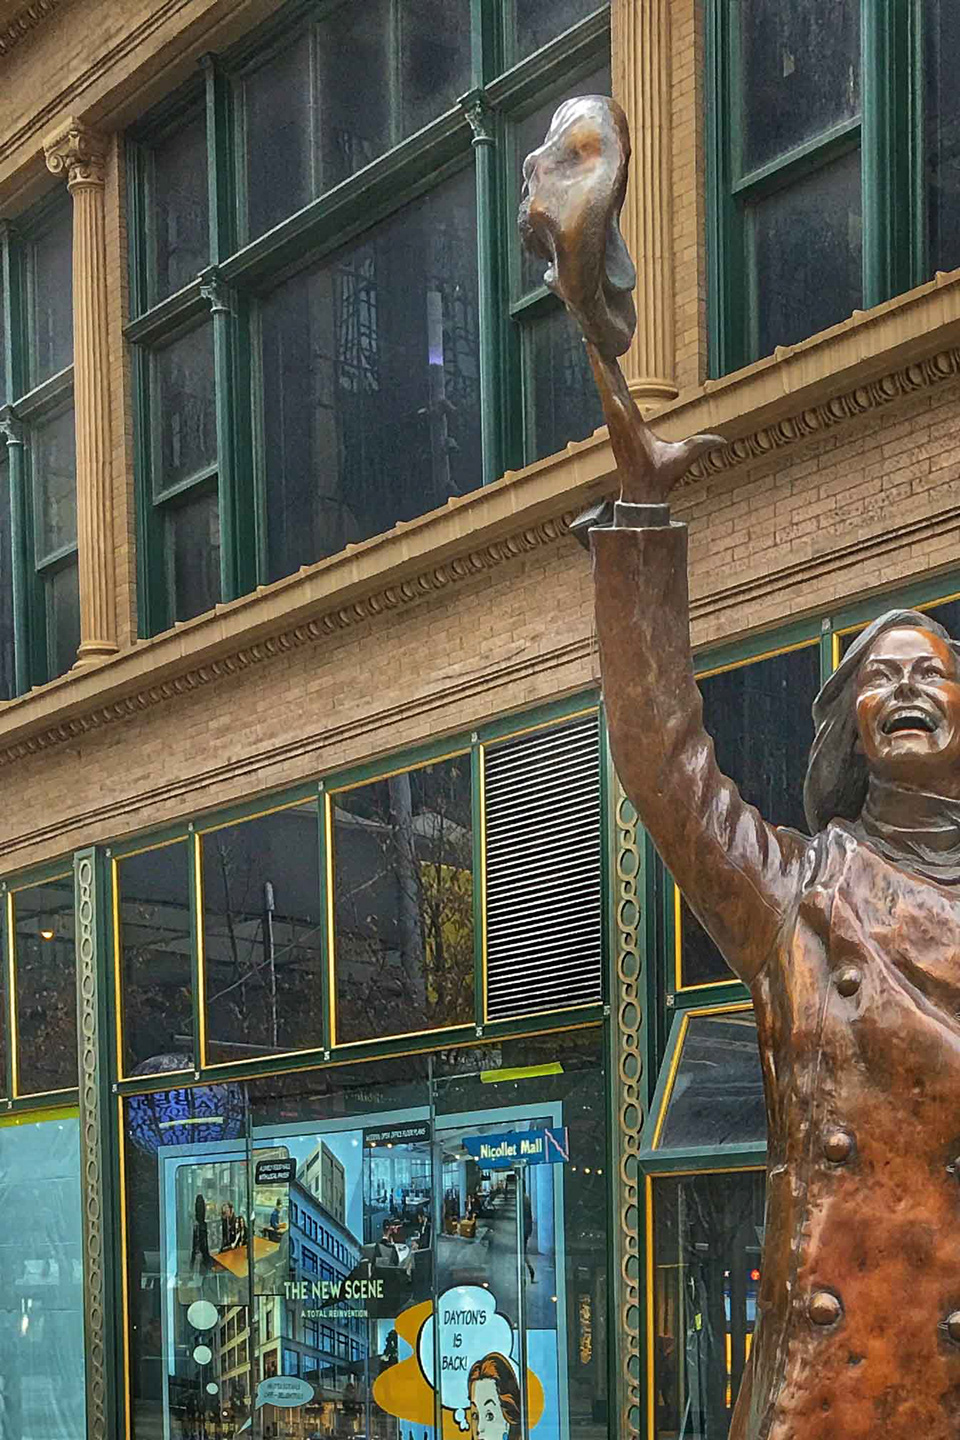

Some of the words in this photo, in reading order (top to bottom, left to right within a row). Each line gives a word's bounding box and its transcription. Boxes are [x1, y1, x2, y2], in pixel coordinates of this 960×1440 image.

[480, 1141, 518, 1159] Nicollet
[520, 1137, 543, 1155] Mall
[283, 1281, 309, 1300] THE
[312, 1280, 342, 1299] NEW
[345, 1279, 384, 1299] SCENE
[300, 1309, 306, 1318] A
[307, 1309, 327, 1318] TOTAL
[328, 1309, 368, 1318] REINVENTION
[443, 1309, 487, 1326] DAYTON'S
[452, 1332, 463, 1349] IS
[441, 1355, 468, 1372] BACK!
